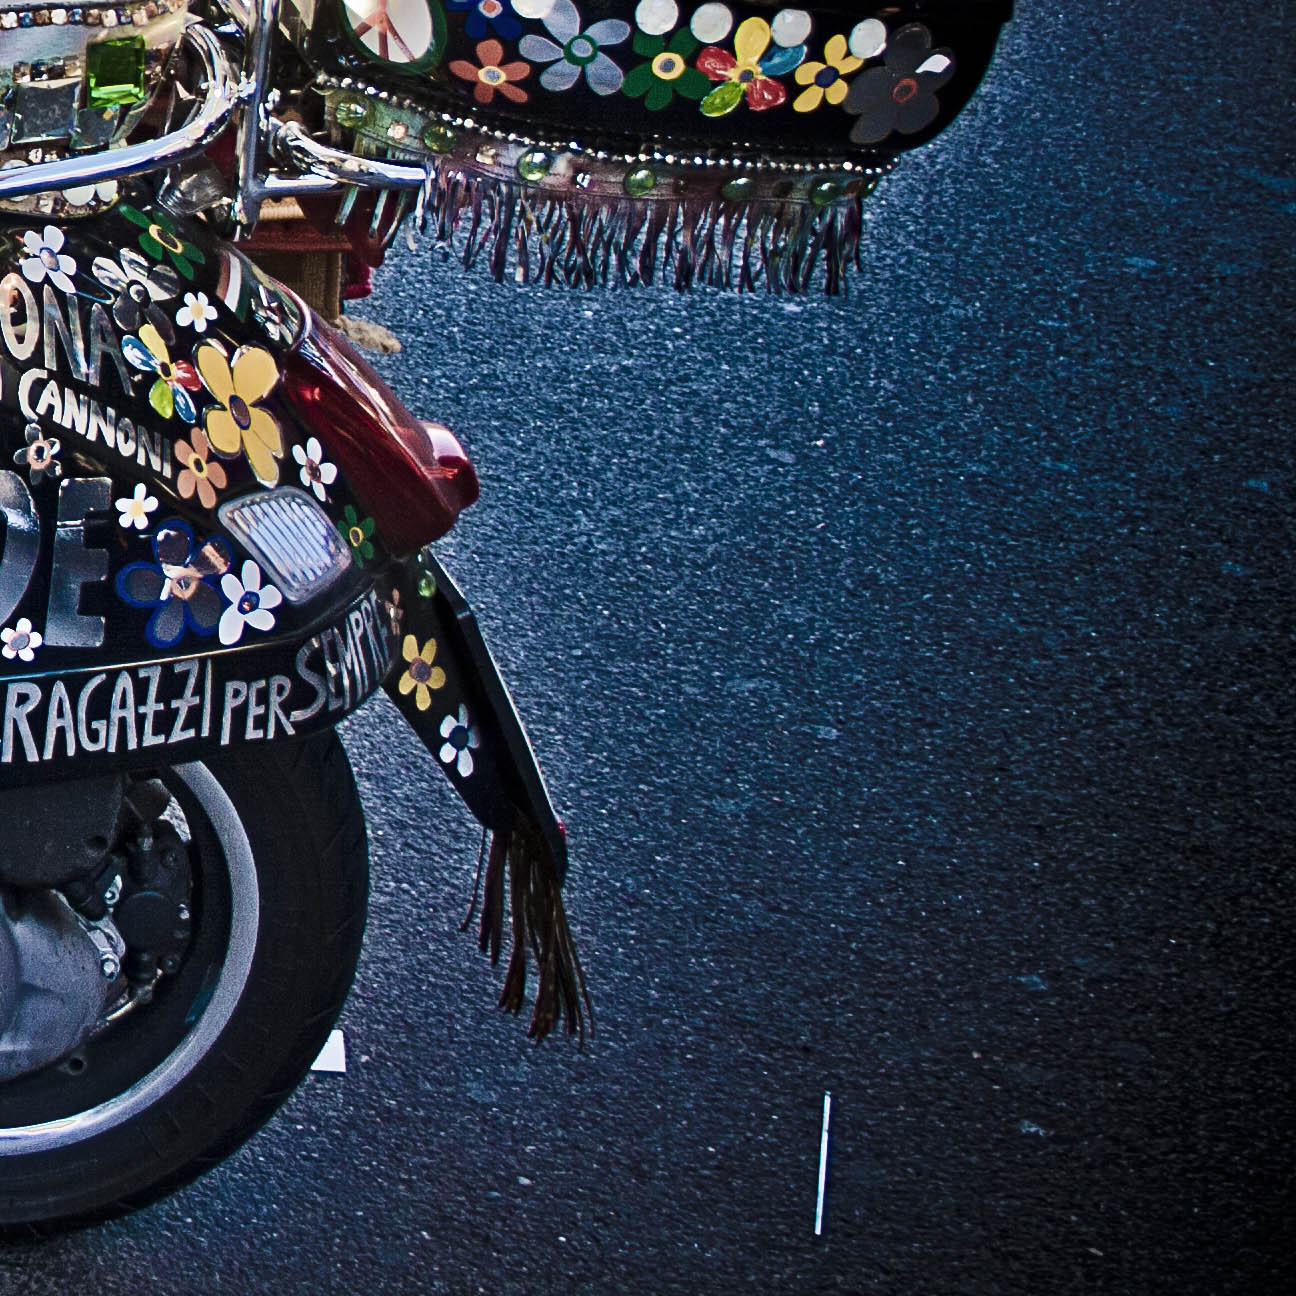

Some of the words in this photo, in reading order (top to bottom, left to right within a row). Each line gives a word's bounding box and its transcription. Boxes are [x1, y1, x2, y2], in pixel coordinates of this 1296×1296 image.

[18, 366, 172, 480] CANNONI
[1, 660, 212, 763] RAGAZZI
[220, 674, 299, 746] PER
